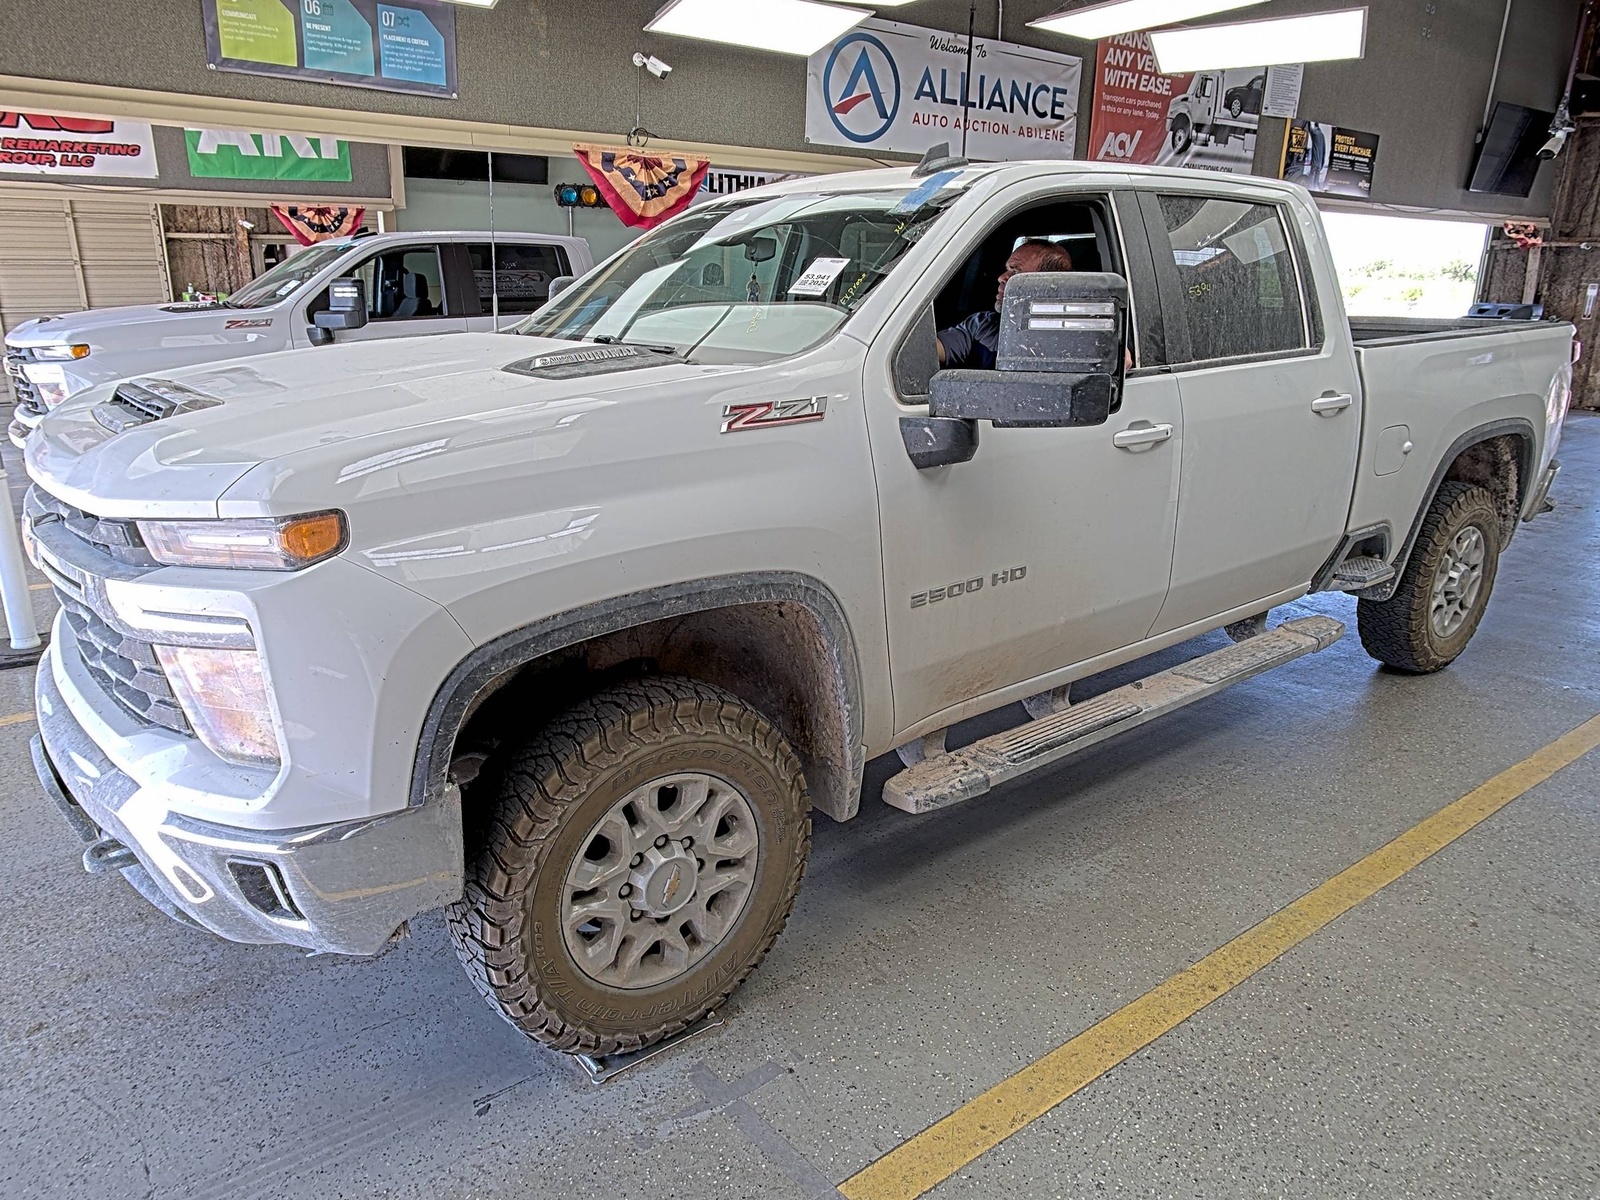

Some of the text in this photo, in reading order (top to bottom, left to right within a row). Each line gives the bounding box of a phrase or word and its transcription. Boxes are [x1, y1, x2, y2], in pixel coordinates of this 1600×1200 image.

[304, 0, 320, 15] 06
[312, 23, 332, 32] PRESENT
[382, 11, 395, 27] 07
[383, 34, 407, 43] PLACEMENT
[411, 38, 430, 47] CRITICAL
[975, 43, 987, 58] To
[1104, 47, 1135, 69] ANY
[1104, 68, 1172, 96] WITH EASE.
[914, 65, 1068, 121] ALLIANCE
[1102, 92, 1162, 109] Transport cars purchased
[1101, 103, 1106, 111] in
[1106, 104, 1116, 113] this
[1122, 108, 1132, 117] any
[1132, 108, 1145, 117] lane.
[912, 112, 948, 128] AUTO
[953, 117, 1009, 135] AUCTION
[1018, 126, 1065, 142] ABILENE
[2, 137, 141, 156] REMARKETING
[1096, 130, 1143, 160] ACV
[1334, 143, 1349, 153] EVERY
[1335, 134, 1356, 146] PROTECT
[59, 154, 95, 167] LLC
[708, 172, 766, 195] LITHIA
[576, 346, 639, 363] DURAMAX
[720, 395, 828, 434] Z71
[910, 564, 1027, 609] 2500 HD
